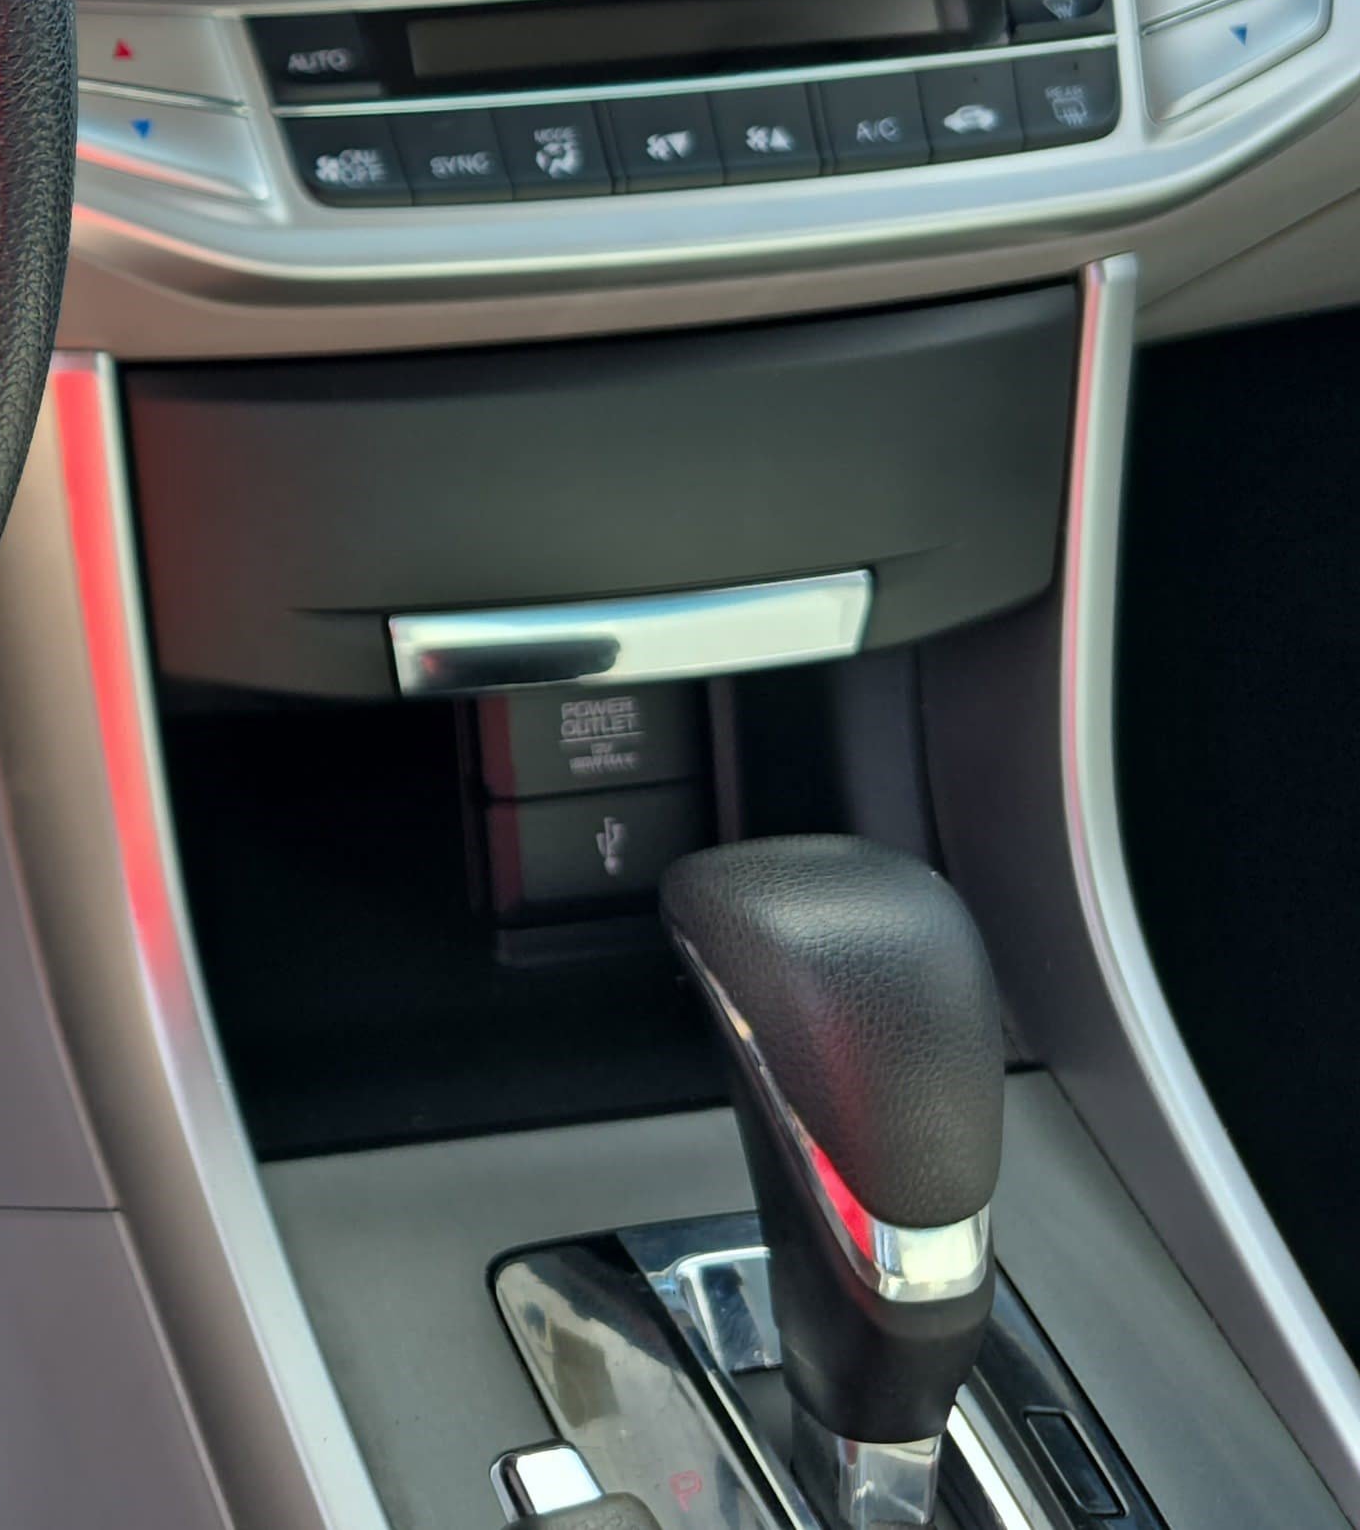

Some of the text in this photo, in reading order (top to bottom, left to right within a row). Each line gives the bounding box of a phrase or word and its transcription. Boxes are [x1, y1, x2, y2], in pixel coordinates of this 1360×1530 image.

[288, 48, 349, 72] AUTO
[855, 117, 898, 143] A/C
[430, 151, 489, 178] SYNC
[561, 697, 636, 720] POWER
[561, 714, 639, 738] OUTLET
[670, 1469, 703, 1511] P
